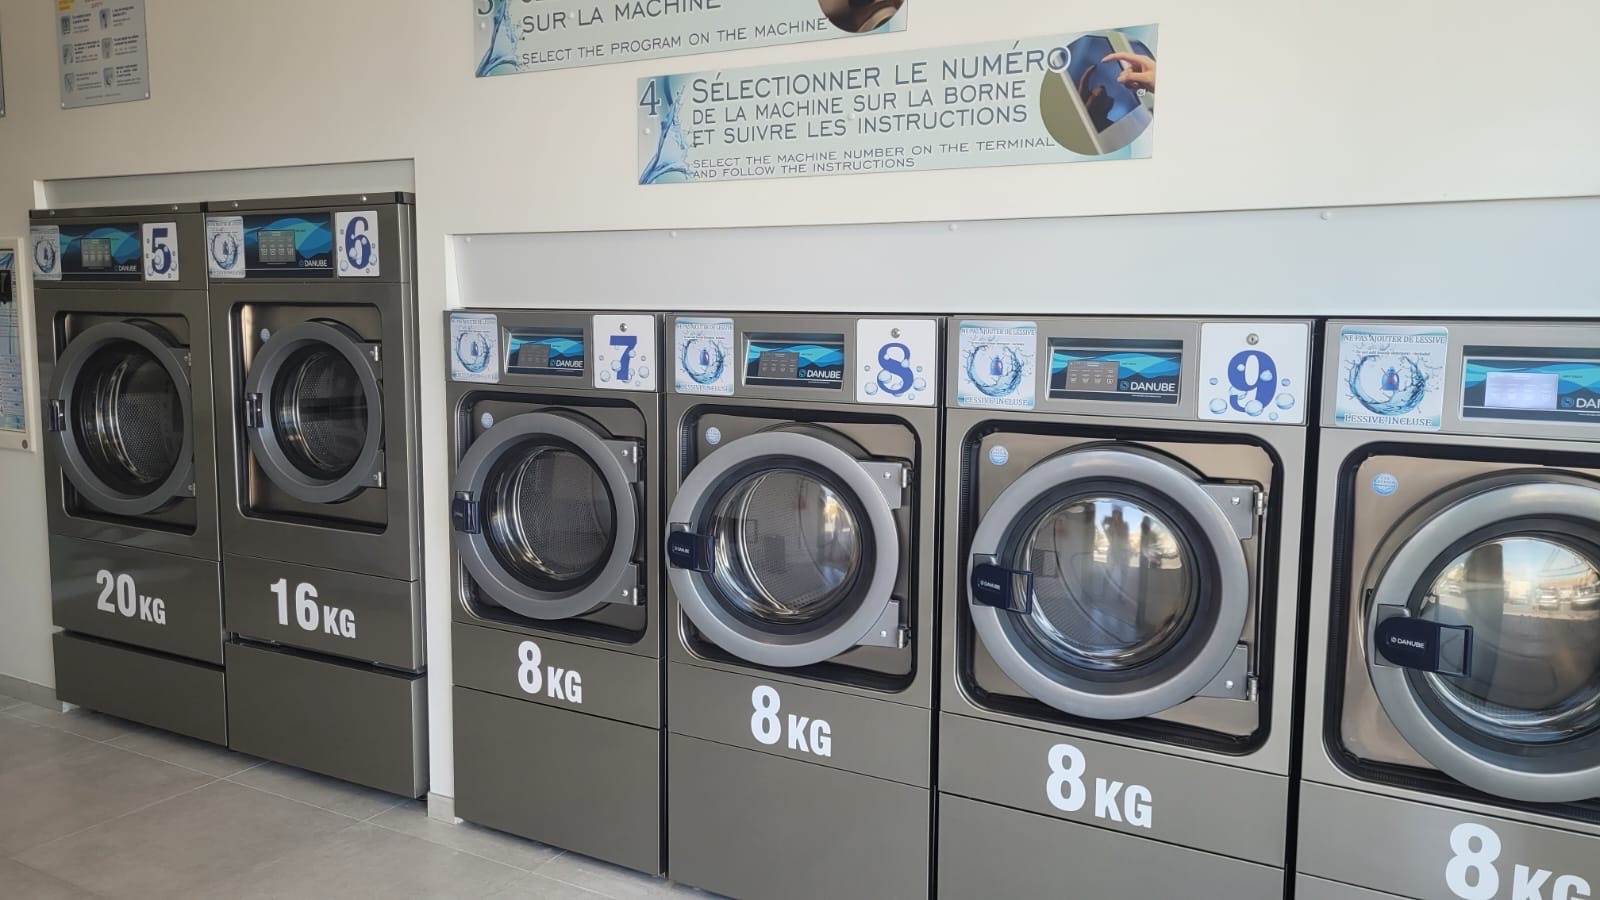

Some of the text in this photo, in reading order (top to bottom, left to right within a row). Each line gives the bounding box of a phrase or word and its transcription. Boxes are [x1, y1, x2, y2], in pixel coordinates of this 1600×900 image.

[522, 11, 567, 34] SUR
[578, 8, 603, 26] LA
[522, 18, 828, 65] SELECT THE PROGRAM ON THE MACHINE
[692, 40, 1071, 104] SÉLECTIONNER LE NUMÉRO
[638, 80, 661, 116] 4
[693, 80, 1026, 125] DE LA MACHINE SUR LA BORNE
[693, 104, 1028, 146] ET SUIVRE LES INSTRUCTIONS
[693, 137, 1055, 168] SELECT THE MACHINE NUMBER ON THE TERMINAL
[693, 157, 915, 179] AND FOLLOW THE INSTRUCTIONS
[152, 228, 172, 275] 5
[304, 259, 328, 268] DANUBE
[344, 216, 372, 270] 6
[555, 359, 584, 369] DANUBE
[609, 335, 638, 381] 7
[806, 369, 841, 379] DANUBE
[876, 342, 914, 395] 8
[1227, 349, 1278, 413] 9
[1130, 381, 1175, 392] DANUBE
[1575, 398, 1600, 408] DA
[96, 569, 166, 625] 20 KG
[270, 578, 356, 639] 16 KG
[1397, 638, 1424, 649] DANUBE
[517, 640, 583, 704] 8 KG
[750, 685, 832, 757] 8 KG
[1046, 743, 1153, 829] 8 KG
[1445, 822, 1502, 900] 8
